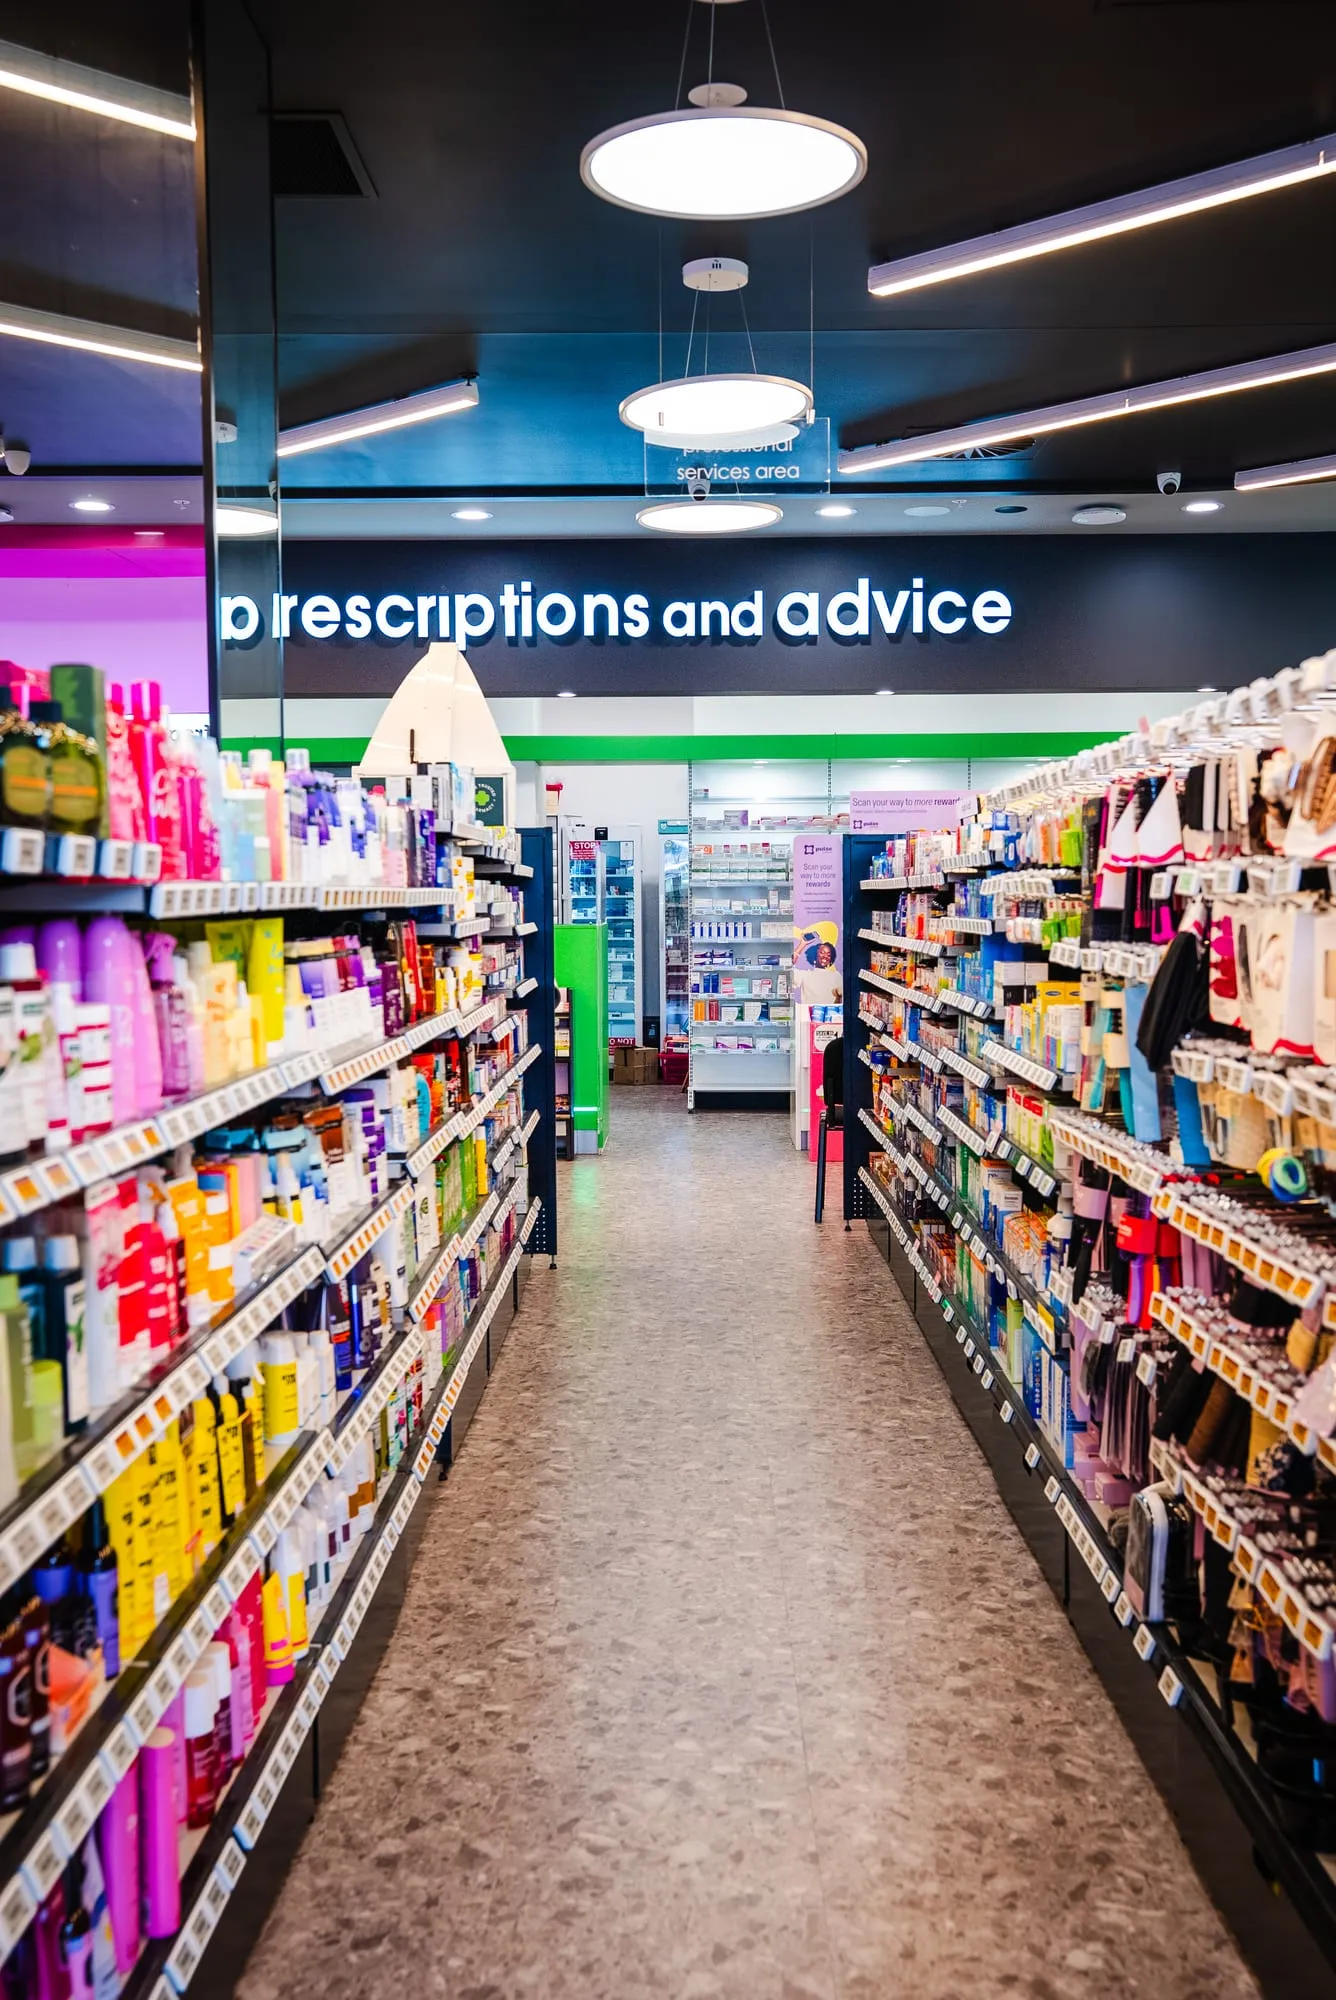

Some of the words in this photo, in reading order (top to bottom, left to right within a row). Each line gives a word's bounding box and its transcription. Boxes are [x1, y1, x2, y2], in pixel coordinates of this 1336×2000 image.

[677, 463, 750, 480] services
[755, 465, 800, 479] area
[663, 590, 764, 637] and
[776, 578, 1013, 637] advice
[852, 797, 871, 807] Scan
[872, 799, 888, 808] your
[889, 799, 904, 808] way
[905, 798, 913, 806] to
[574, 841, 596, 850] STOP
[803, 863, 819, 871] Scan
[820, 864, 833, 872] your
[800, 872, 813, 880] way
